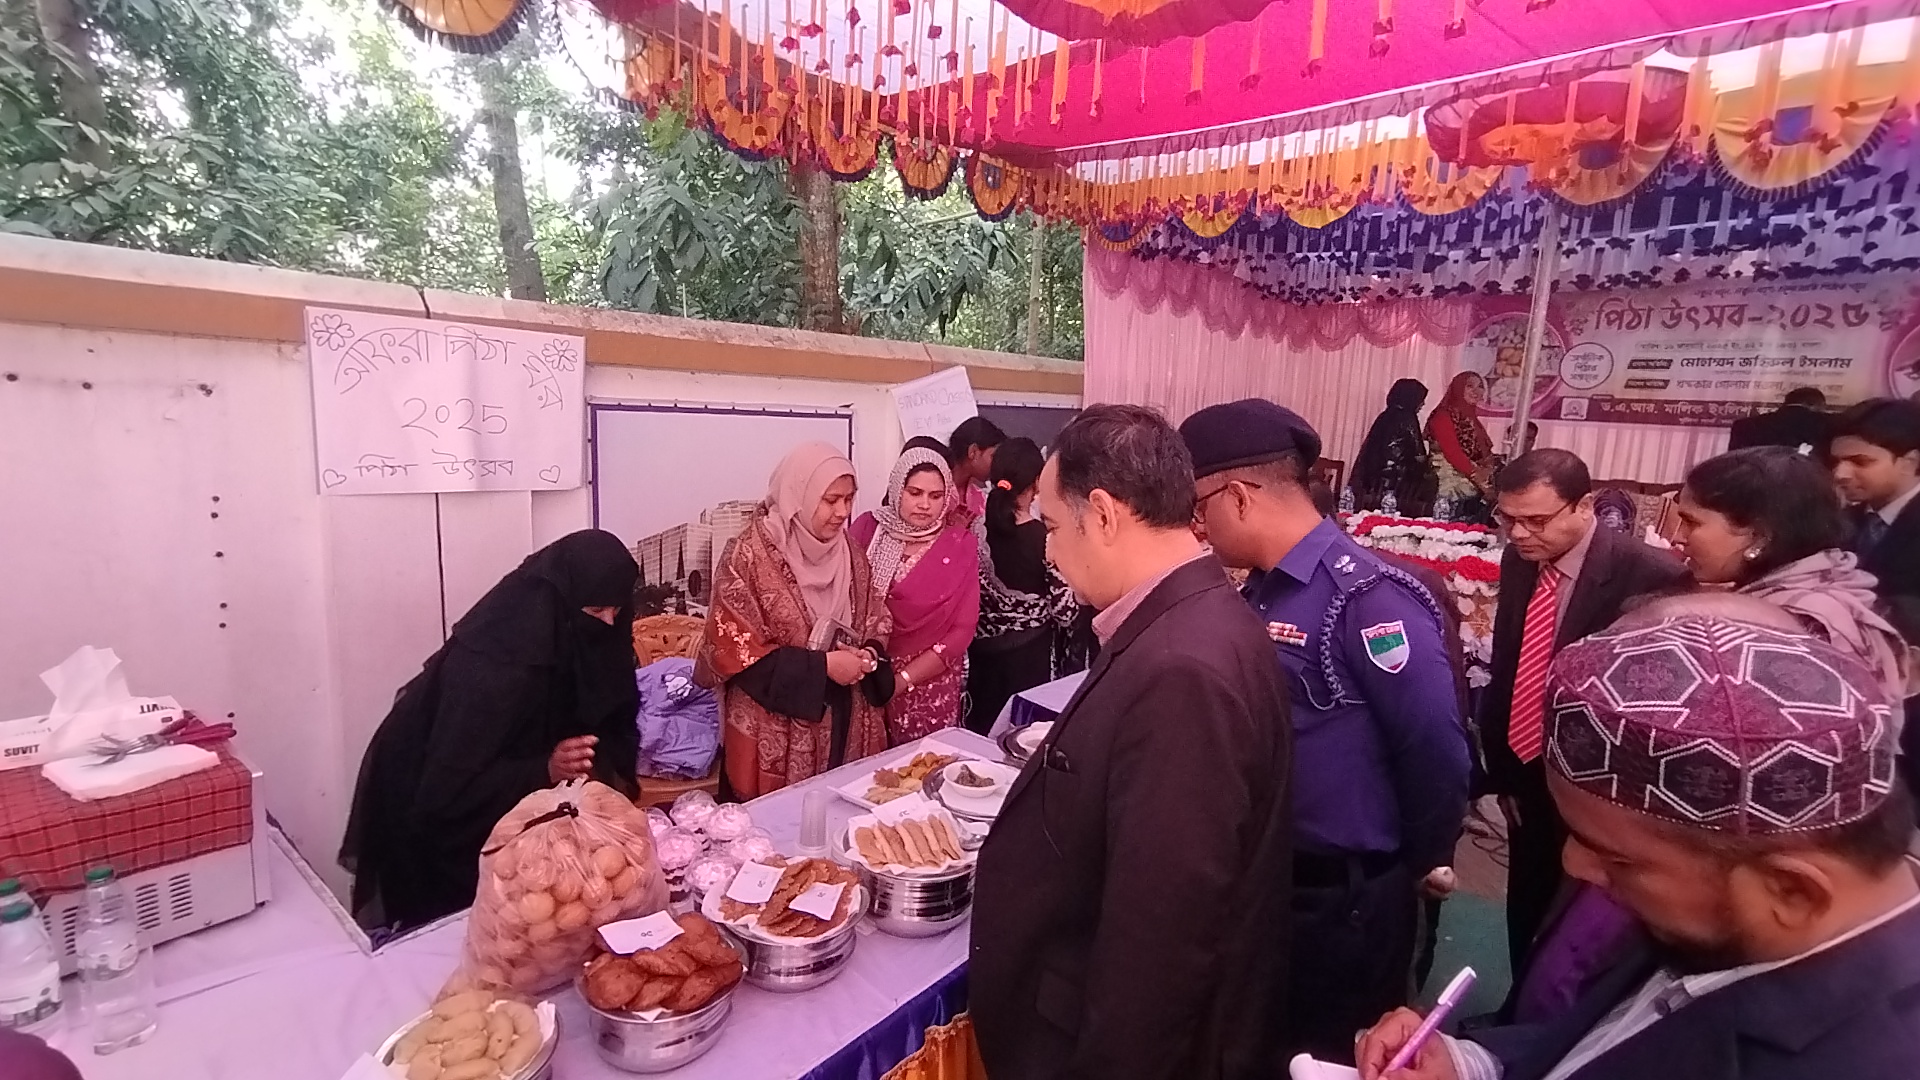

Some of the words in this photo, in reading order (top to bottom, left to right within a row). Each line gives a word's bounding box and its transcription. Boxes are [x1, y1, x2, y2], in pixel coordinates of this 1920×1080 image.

[1595, 298, 1654, 331] পিঠা
[443, 325, 517, 365] পিঠা
[1680, 357, 1735, 368] মোহাম্মদ
[1799, 355, 1853, 369] ইসলাম
[432, 448, 514, 480] উৎসব
[4, 744, 40, 757] SUVIT
